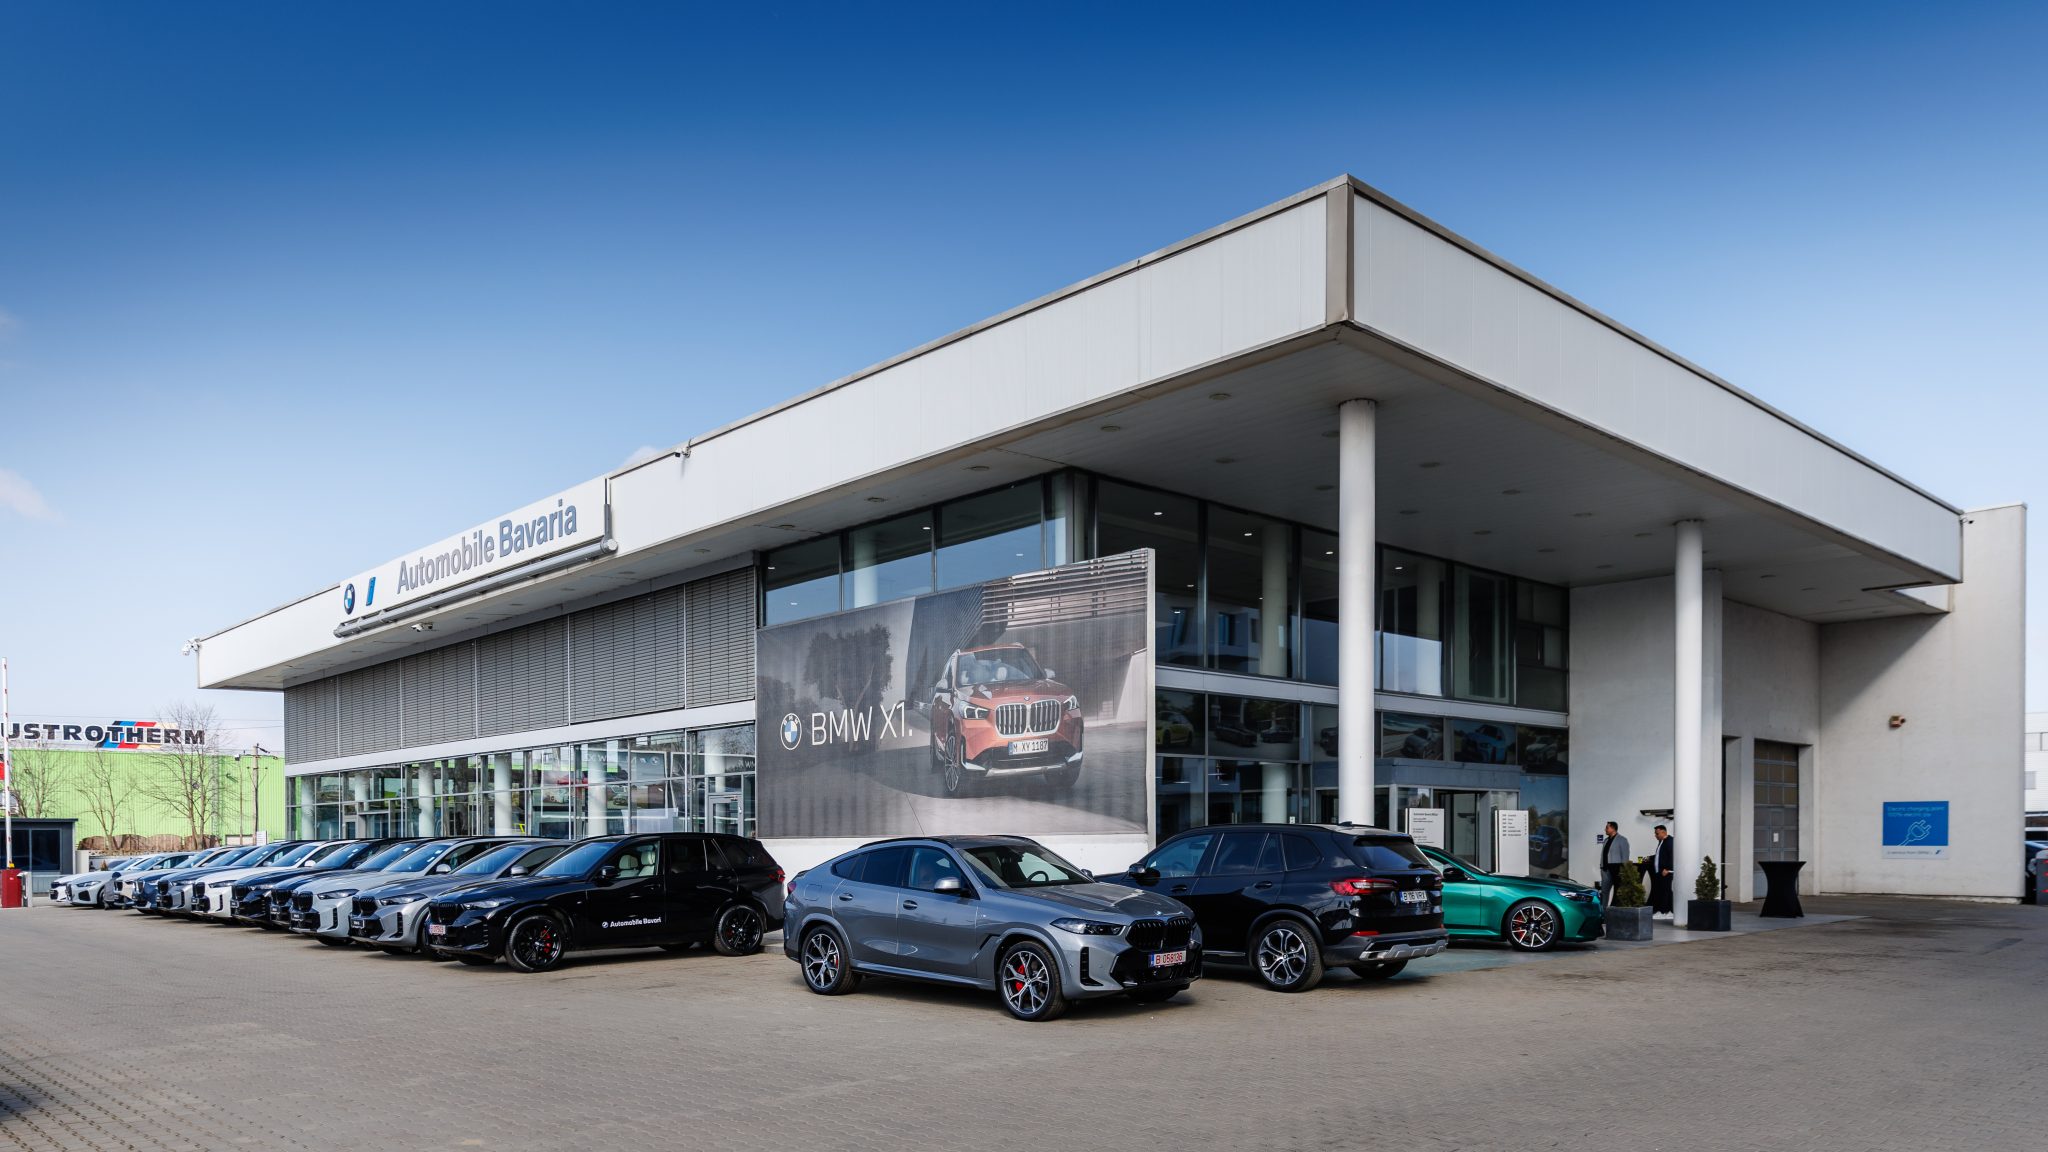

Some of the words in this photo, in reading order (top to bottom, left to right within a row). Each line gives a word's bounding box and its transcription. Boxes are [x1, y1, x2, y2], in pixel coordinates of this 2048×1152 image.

[397, 529, 495, 595] Automobile
[499, 498, 578, 558] Bavaria
[811, 706, 873, 746] BMW
[879, 701, 913, 740] X1.
[609, 919, 643, 928] Automobile
[1156, 955, 1161, 964] B
